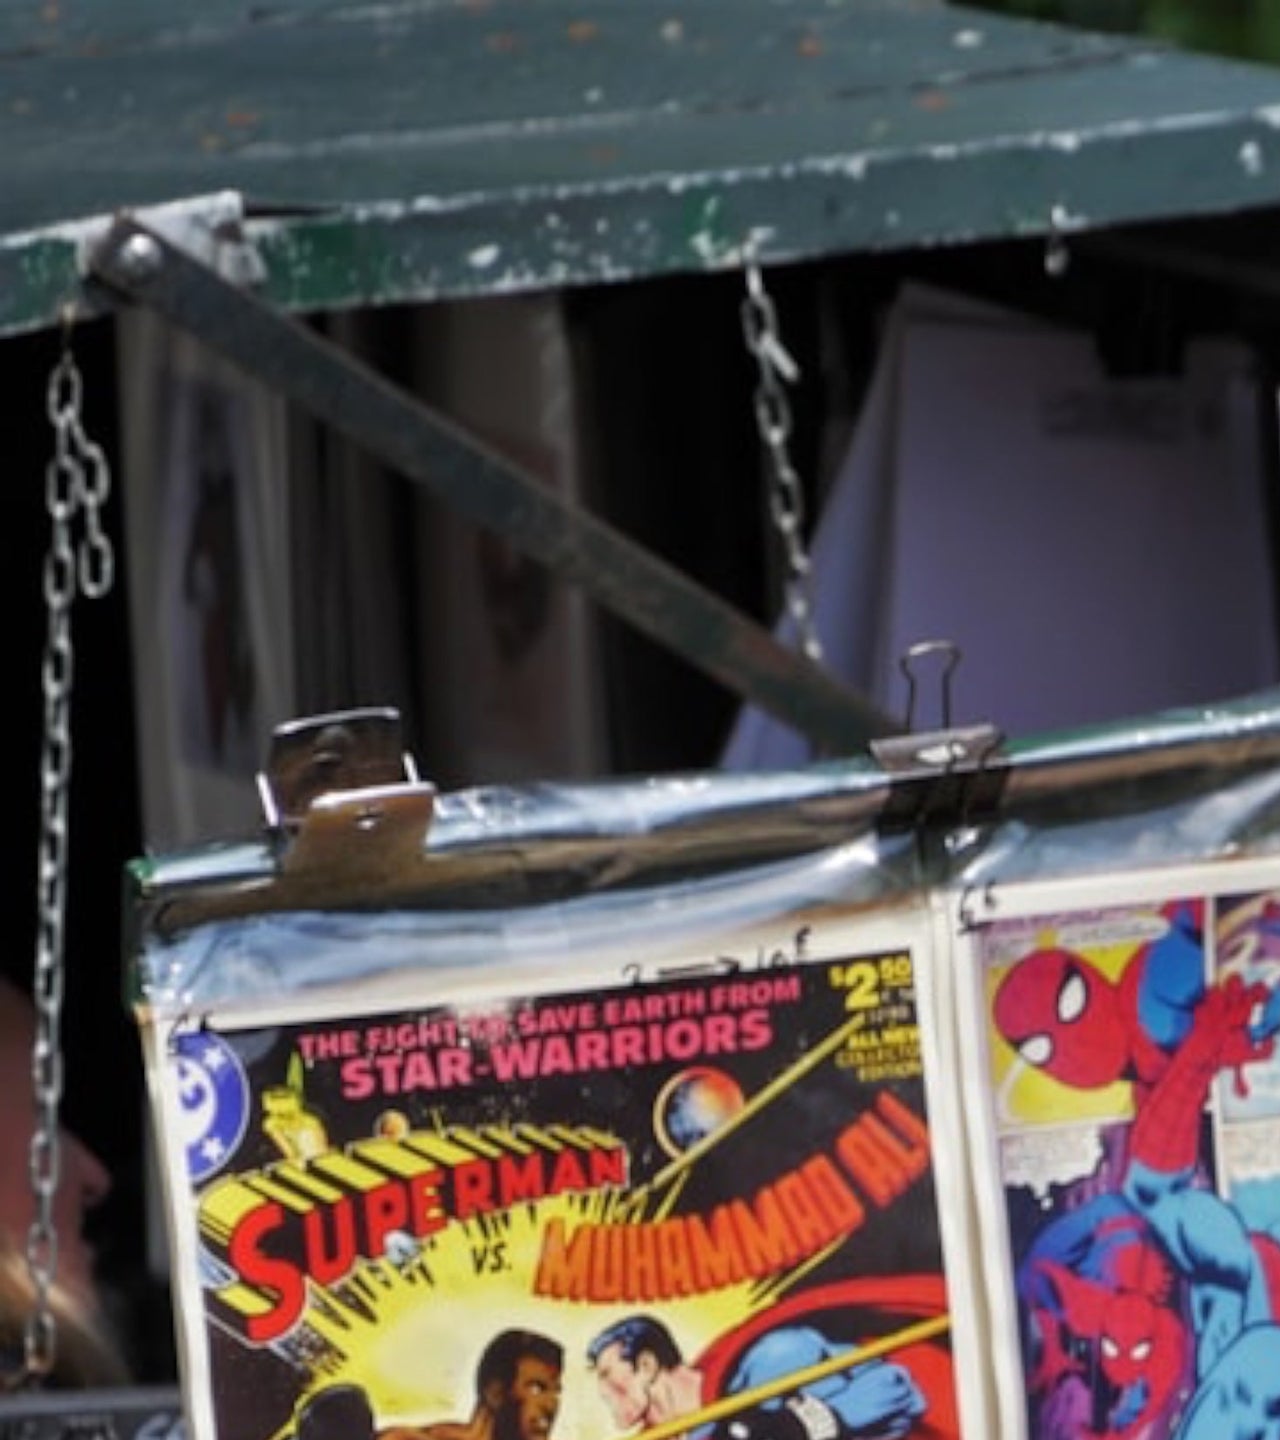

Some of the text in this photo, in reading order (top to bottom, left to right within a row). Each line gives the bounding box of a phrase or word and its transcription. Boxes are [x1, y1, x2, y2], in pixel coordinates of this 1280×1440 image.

[300, 1030, 360, 1061] THE
[364, 1017, 457, 1056] FIGHT
[517, 1002, 595, 1036] SAVE
[602, 989, 702, 1024] EARTH
[704, 974, 801, 1011] FROM
[339, 1008, 774, 1101] STAR-WARRIORS
[228, 1145, 630, 1343] SUPERMAN
[532, 1090, 930, 1302] MUHAMMAD ALI
